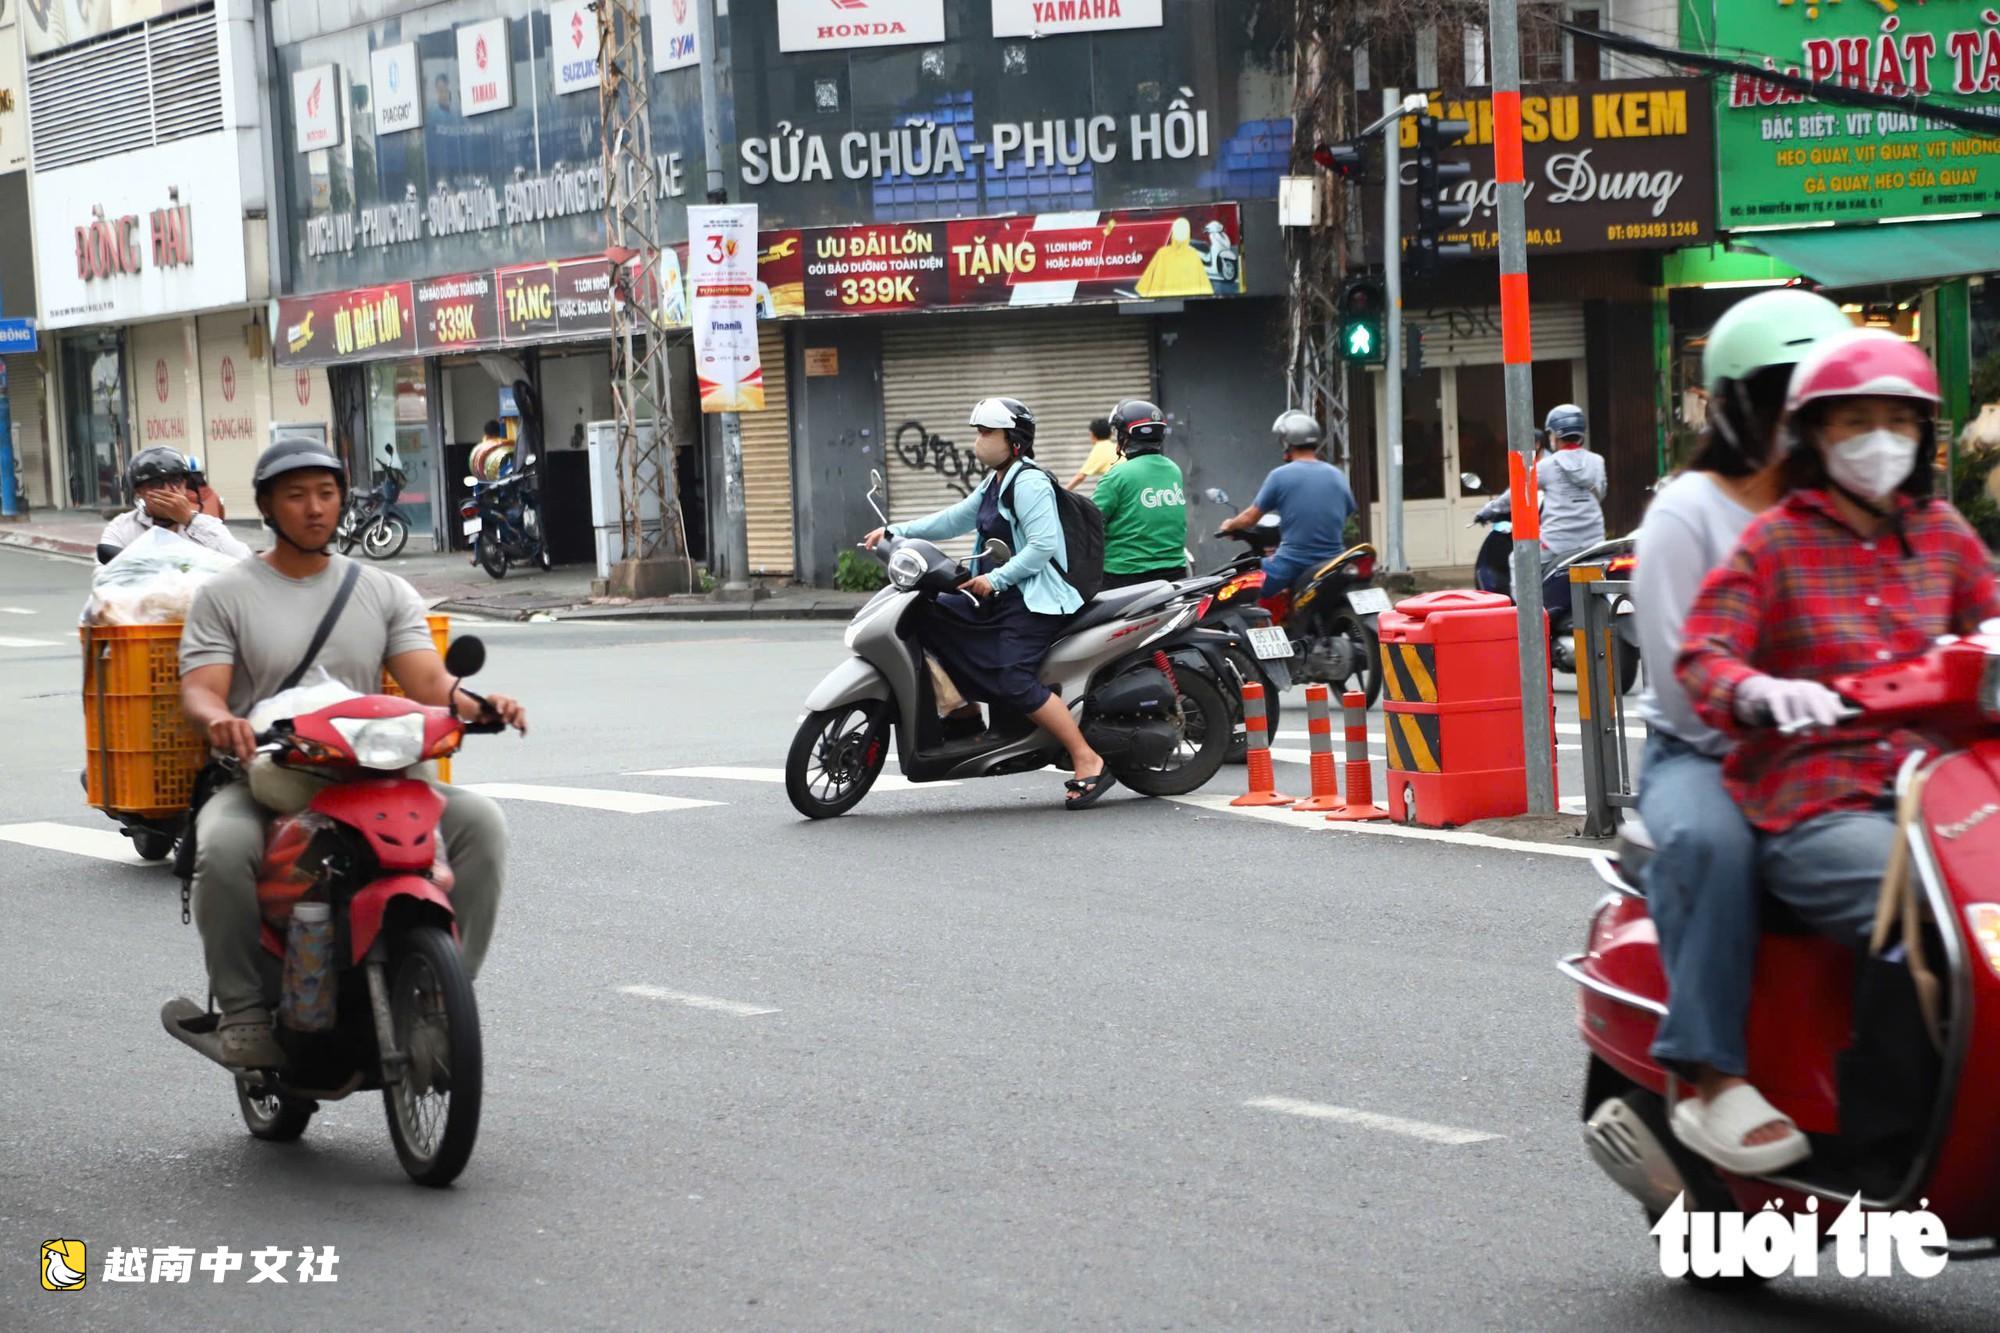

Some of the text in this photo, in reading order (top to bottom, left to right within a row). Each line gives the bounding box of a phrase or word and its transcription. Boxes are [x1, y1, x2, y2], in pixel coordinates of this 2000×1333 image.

[1032, 0, 1122, 23] YAMAHA
[816, 21, 906, 39] HONDA
[1803, 15, 1937, 98] PHÁT
[562, 60, 599, 82] SUZUK
[1520, 96, 1580, 143] SU
[1592, 90, 1688, 139] KEM
[1761, 115, 1793, 144] ĐẶC
[1798, 112, 1841, 142] BIỆT:
[1846, 112, 1873, 138] VỊT
[1877, 111, 1919, 138] QUAY
[741, 120, 832, 185] SỬA
[840, 119, 964, 180] CHỮA
[992, 115, 1117, 176] PHỤC
[1130, 86, 1209, 161] HỒI
[1776, 149, 1806, 167] HEO
[1855, 144, 1876, 168] VỊT
[1926, 141, 1947, 163] VỊT
[656, 152, 683, 199] XE
[1545, 148, 1684, 218] Dung
[1875, 172, 1904, 190] HEO
[1939, 168, 1978, 186] QUAY
[817, 229, 933, 259] ƯU ĐÃI LỚN
[1545, 229, 1562, 244] Q.1
[1626, 223, 1668, 239] 093493
[952, 235, 1036, 284] TẶNG
[1045, 243, 1050, 253] 1
[1050, 241, 1067, 253] LON
[808, 255, 944, 275] GÓI BẢO DƯỠNG TOÀN DIỆN
[1045, 256, 1070, 271] HOẶC
[1071, 254, 1084, 267] ÁO
[1084, 254, 1104, 267] MƯA
[1105, 253, 1124, 266] CAO
[505, 276, 551, 331] TẶNG
[842, 275, 916, 305] 339K
[437, 304, 476, 343] 339K
[1140, 481, 1186, 508] Grab
